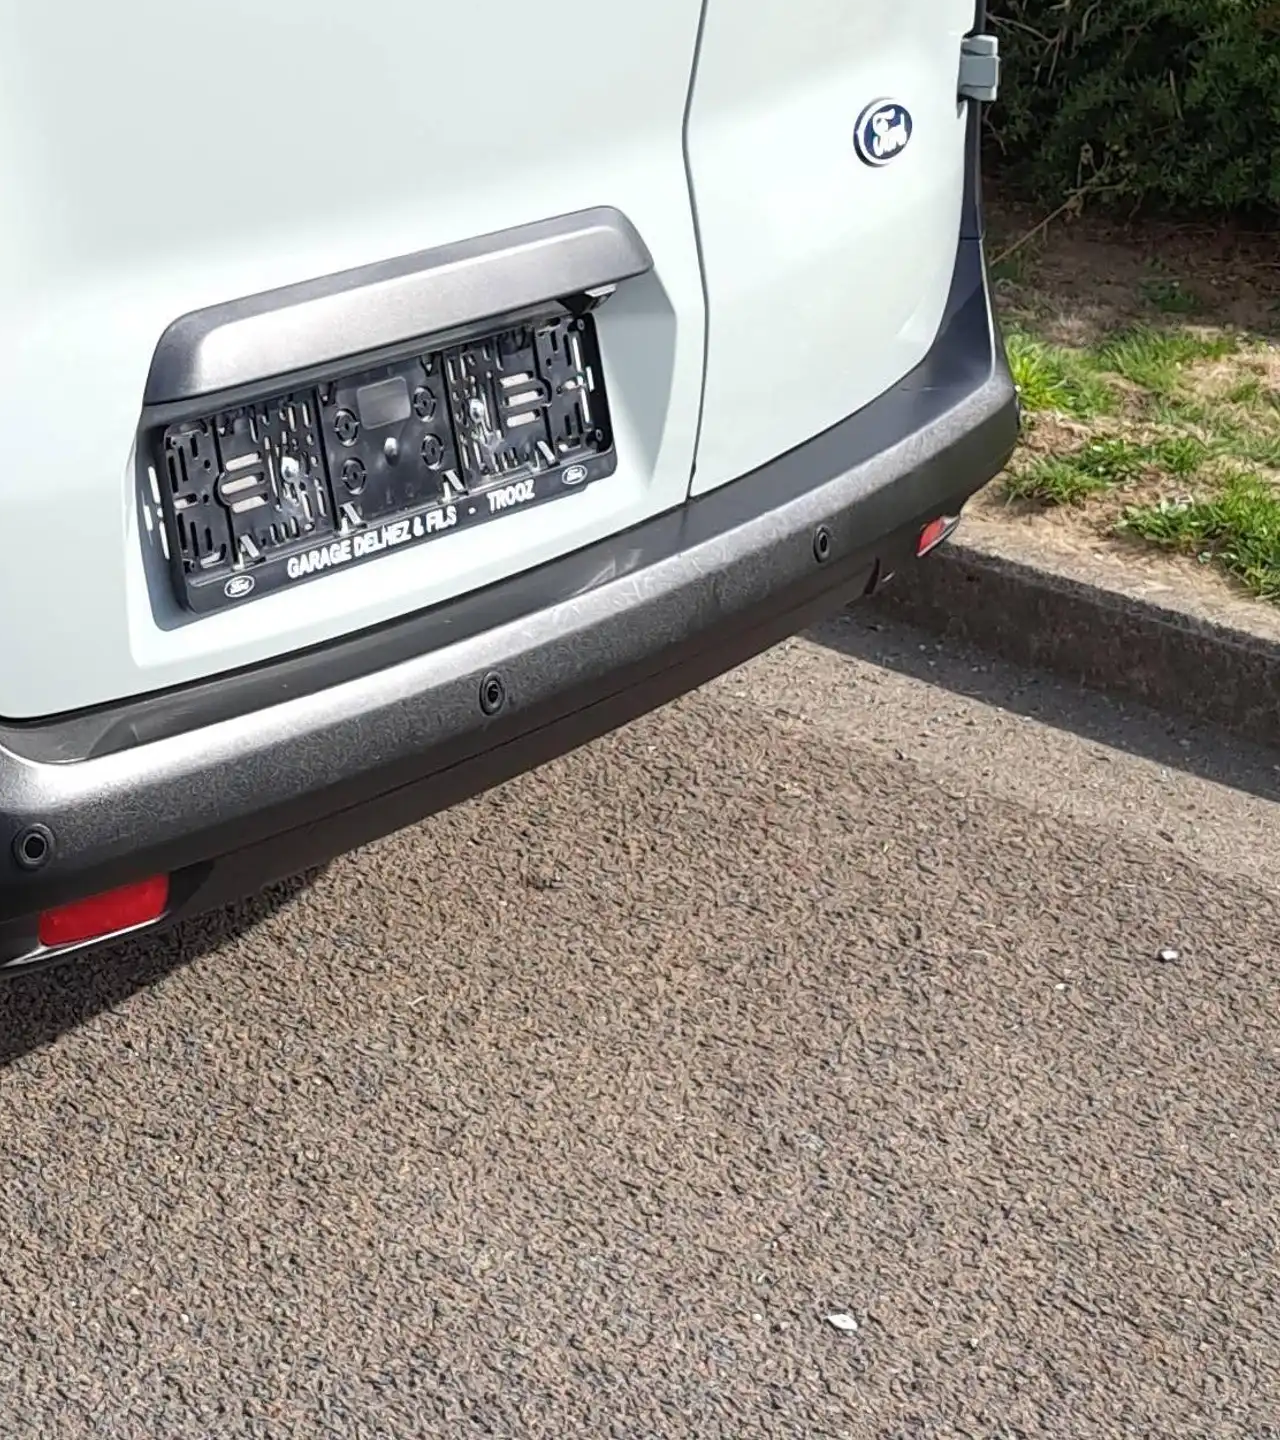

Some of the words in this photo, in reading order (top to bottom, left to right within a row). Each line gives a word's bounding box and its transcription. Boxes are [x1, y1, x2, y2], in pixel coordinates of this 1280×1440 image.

[286, 539, 353, 579] GARAGE
[353, 520, 412, 557] DELHEZ
[425, 505, 458, 534] FILS
[486, 479, 536, 513] TROOZ
